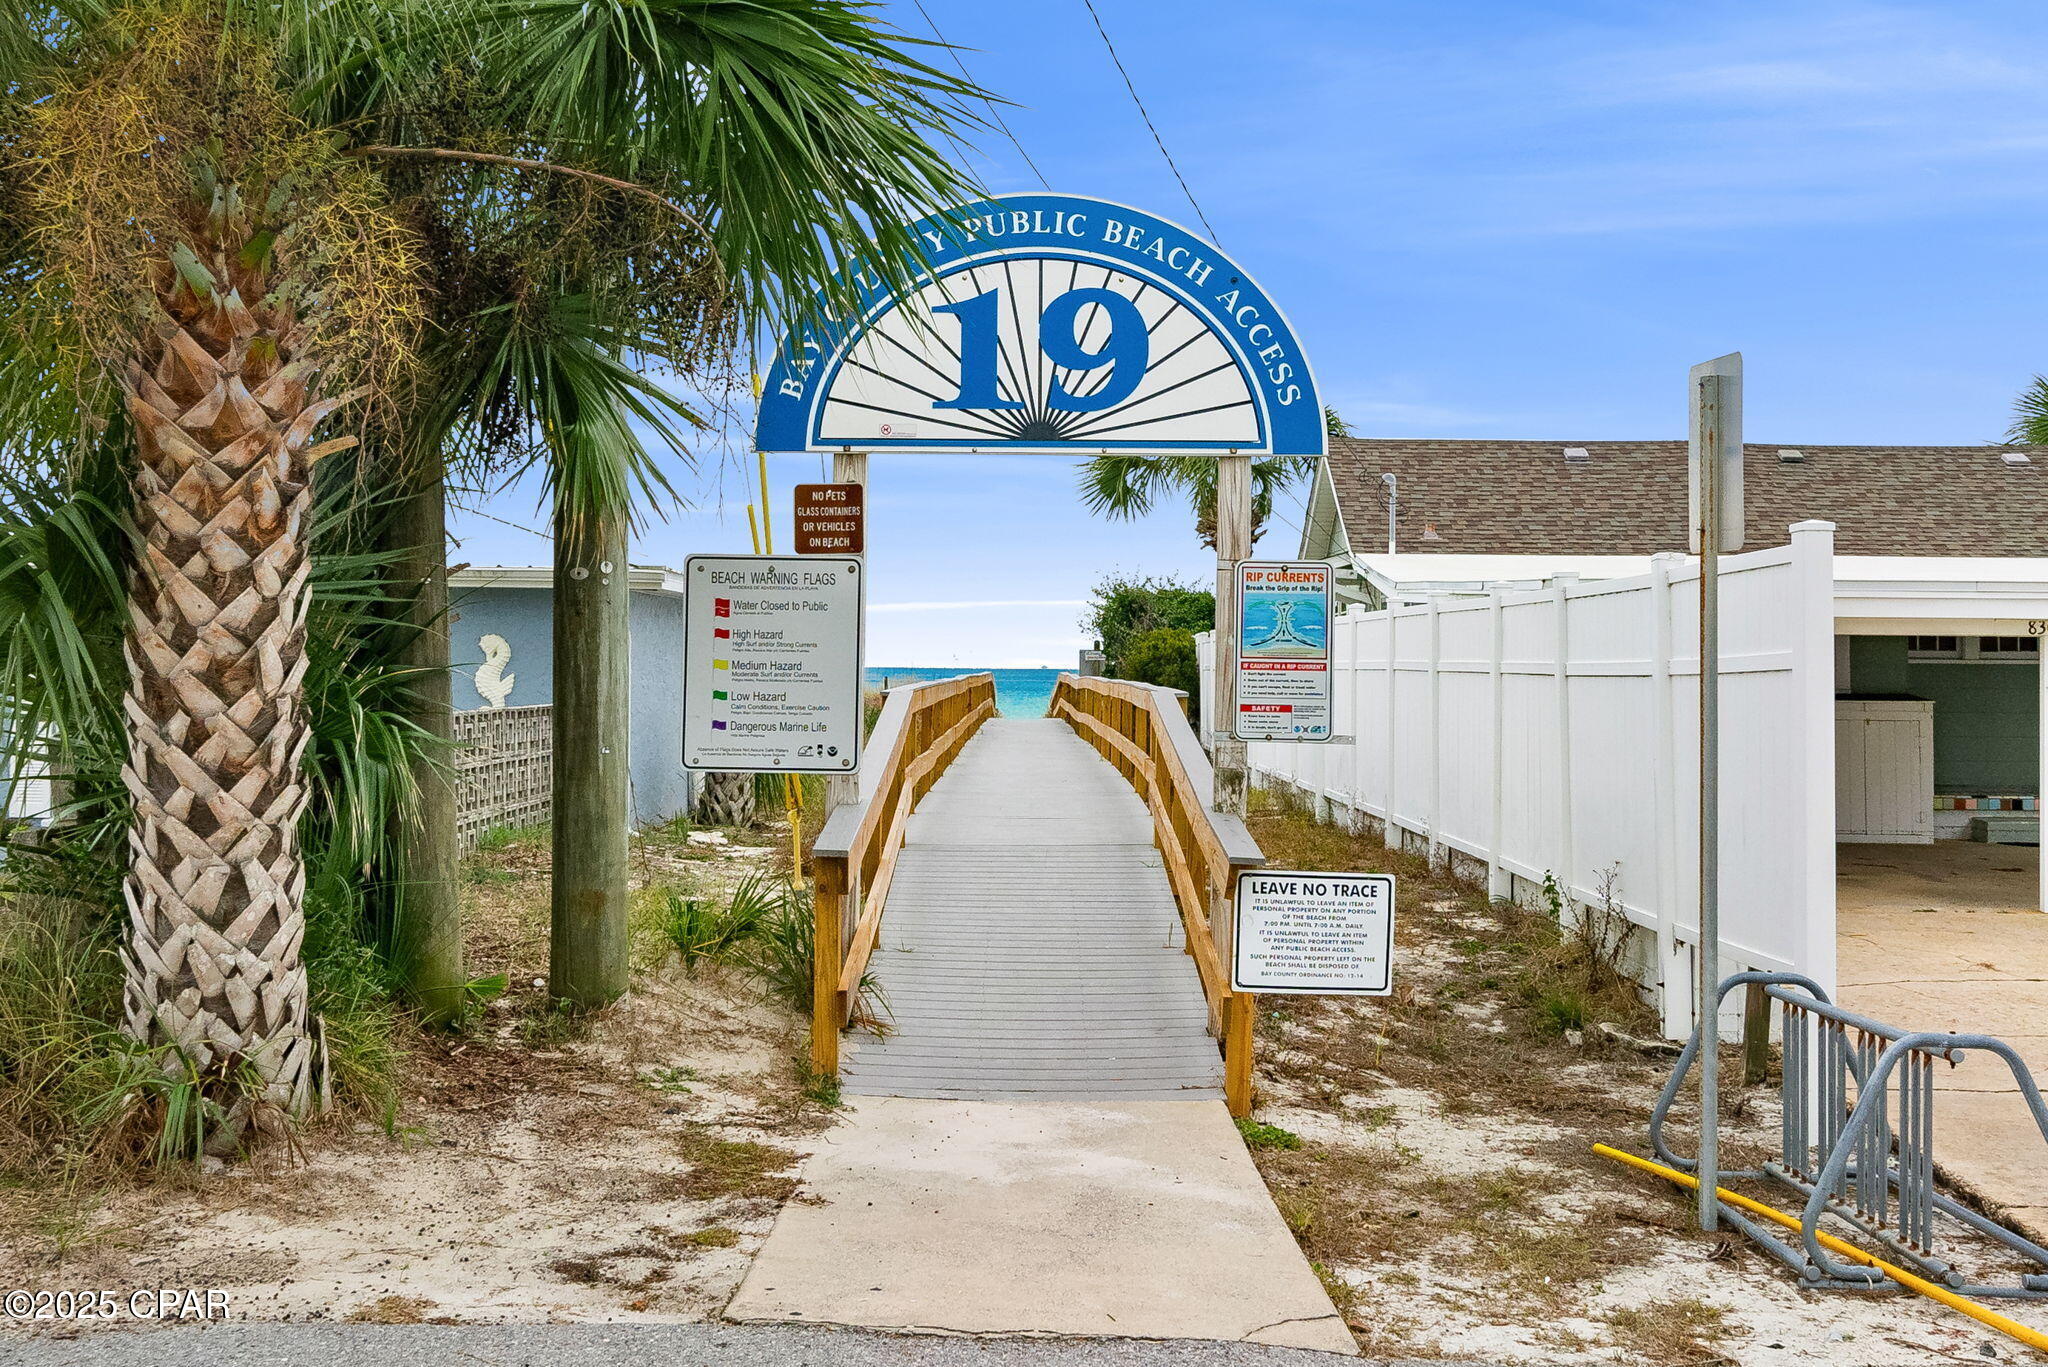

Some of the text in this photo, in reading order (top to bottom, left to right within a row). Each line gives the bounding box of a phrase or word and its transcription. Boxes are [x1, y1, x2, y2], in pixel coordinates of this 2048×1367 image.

[964, 210, 1087, 243] PUBLIC
[1102, 219, 1214, 287] BEACH
[1215, 289, 1301, 406] ACCESS
[931, 287, 1149, 412] 19
[812, 490, 846, 500] NO PETS
[798, 507, 860, 516] GLASS CONTAINERS
[803, 522, 856, 531] OR VEHICLES
[810, 537, 849, 548] ON BEACH
[711, 572, 836, 585] BEACH WARNING FLAGS
[1246, 572, 1324, 583] RIP CURRENTS
[734, 600, 828, 611] Water Closed to Public
[2028, 620, 2048, 635] 83
[732, 629, 783, 641] High Hazard
[731, 660, 802, 671] Medium Hazard
[731, 691, 786, 702] Low Hazard
[730, 721, 826, 733] Dangerous Marine Life
[1252, 882, 1378, 898] LEAVE NO TRACE
